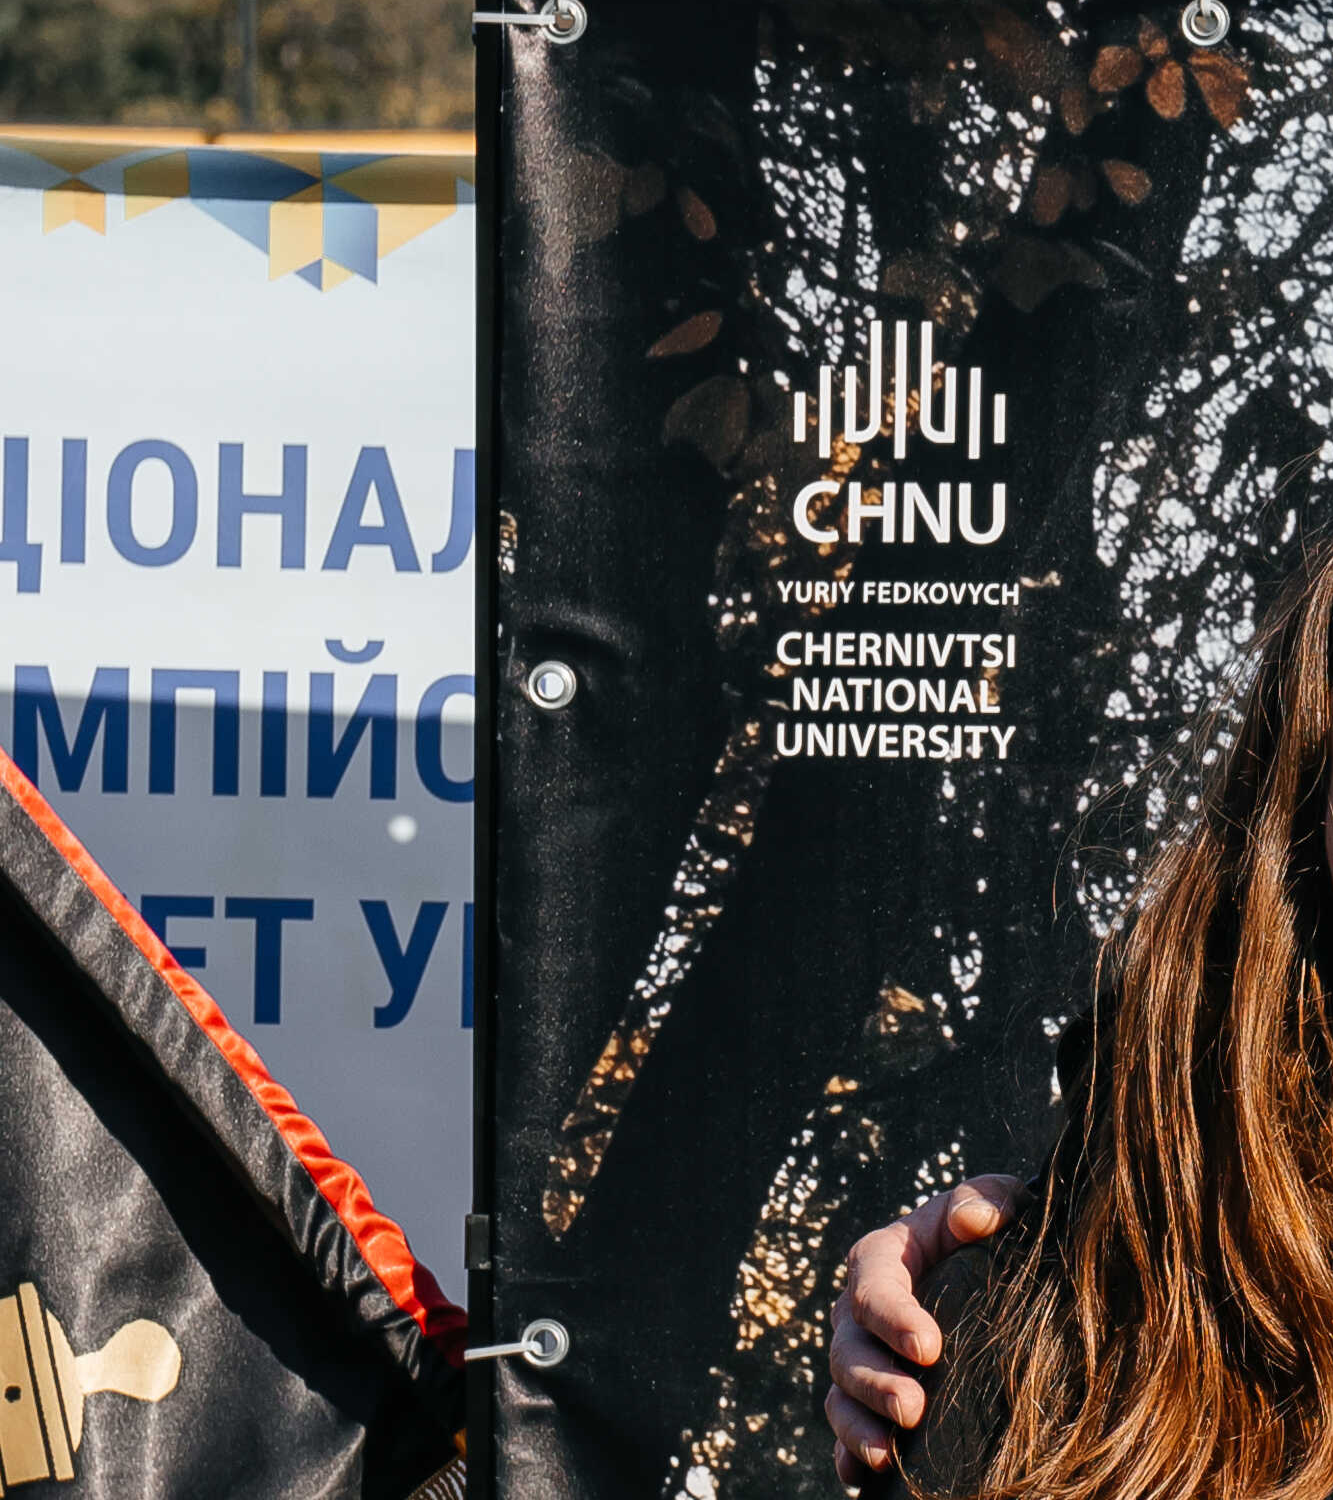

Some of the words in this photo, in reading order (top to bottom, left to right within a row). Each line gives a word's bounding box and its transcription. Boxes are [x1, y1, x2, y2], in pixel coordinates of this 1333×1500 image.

[793, 480, 1007, 545] CHNU
[777, 580, 855, 605] YURIY
[862, 580, 1021, 606] FEDKOVYCH
[776, 631, 1017, 668] CHERNIVTSI
[793, 677, 1000, 714] NATIONAL
[776, 722, 1017, 760] UNIVERSITY
[359, 899, 474, 1029] У
